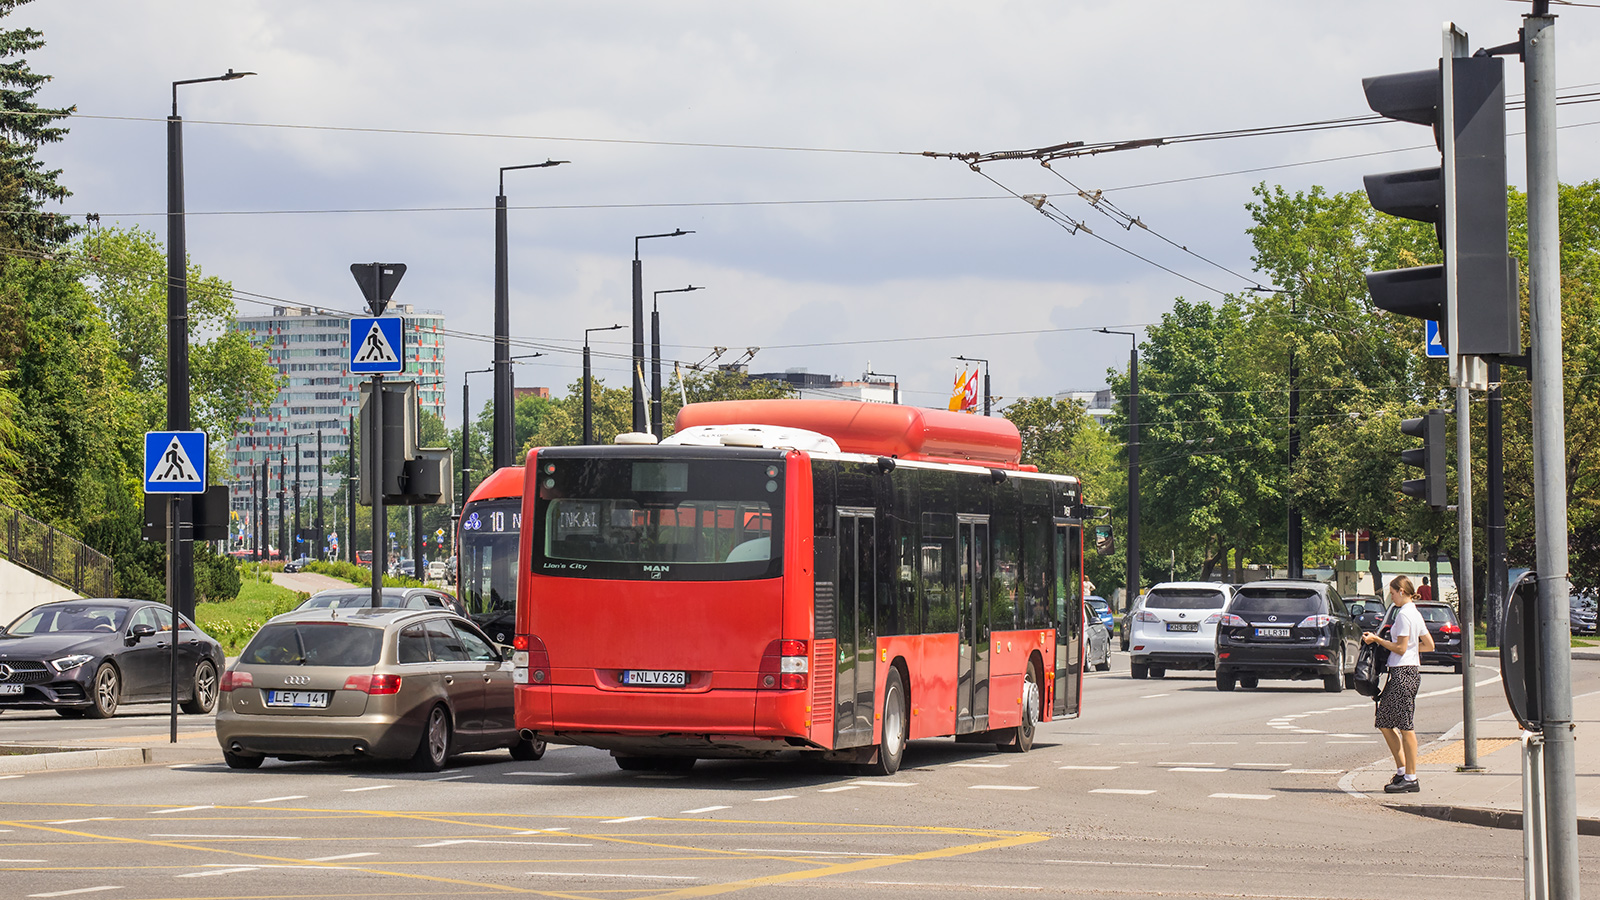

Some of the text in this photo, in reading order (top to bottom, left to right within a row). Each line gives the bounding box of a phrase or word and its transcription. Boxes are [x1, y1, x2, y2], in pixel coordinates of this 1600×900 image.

[490, 511, 504, 532] 10
[569, 562, 588, 571] City
[636, 671, 683, 684] NLV626
[274, 692, 326, 704] LEY 141
